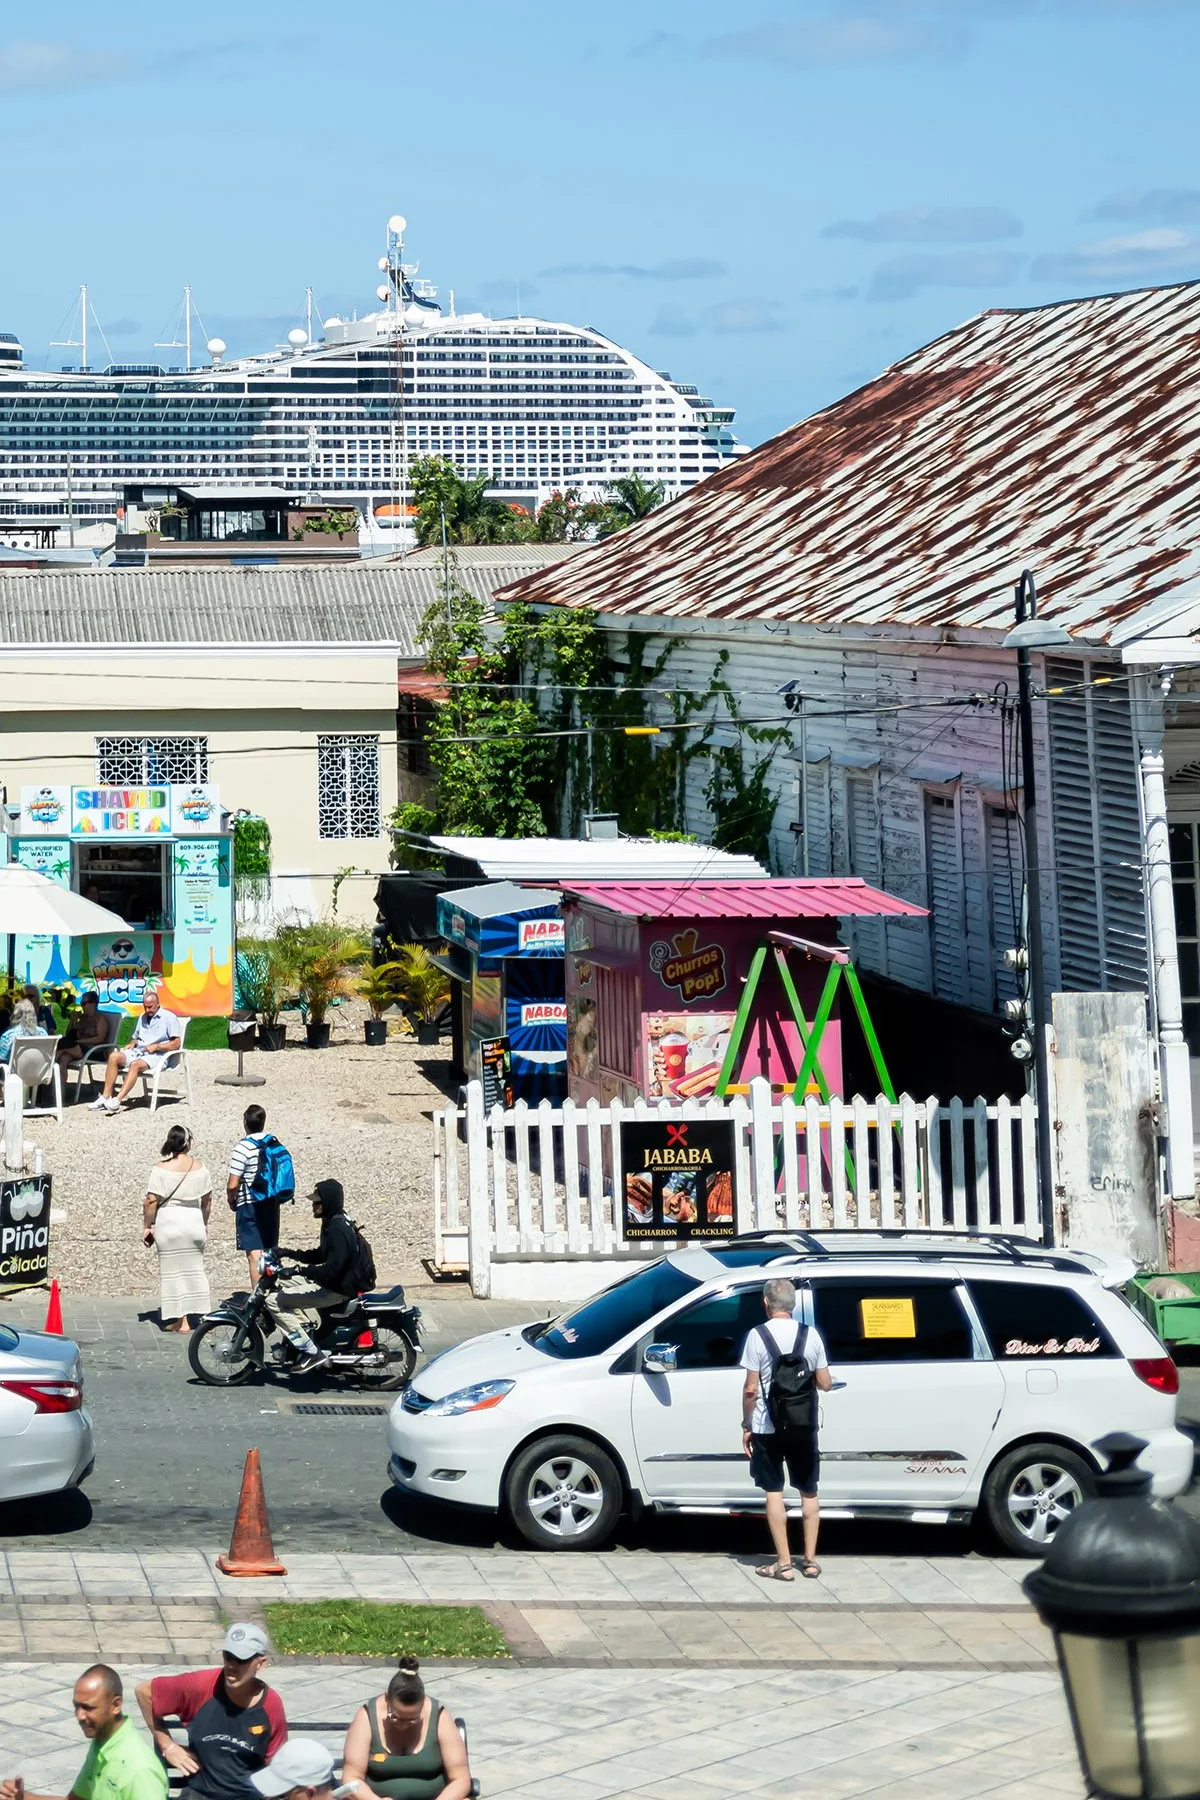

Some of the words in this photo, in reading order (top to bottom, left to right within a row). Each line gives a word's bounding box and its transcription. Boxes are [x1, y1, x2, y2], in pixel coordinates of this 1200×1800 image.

[75, 790, 166, 809] SHAVED
[102, 811, 140, 831] ICE
[666, 950, 718, 980] Churros
[98, 979, 146, 1004] ICE
[684, 968, 720, 994] Pop!
[643, 1148, 713, 1168] JABABA
[2, 1224, 48, 1254] Piña
[626, 1229, 678, 1237] CHICHARRON
[690, 1228, 734, 1236] CRACKLING
[0, 1255, 48, 1276] Colada
